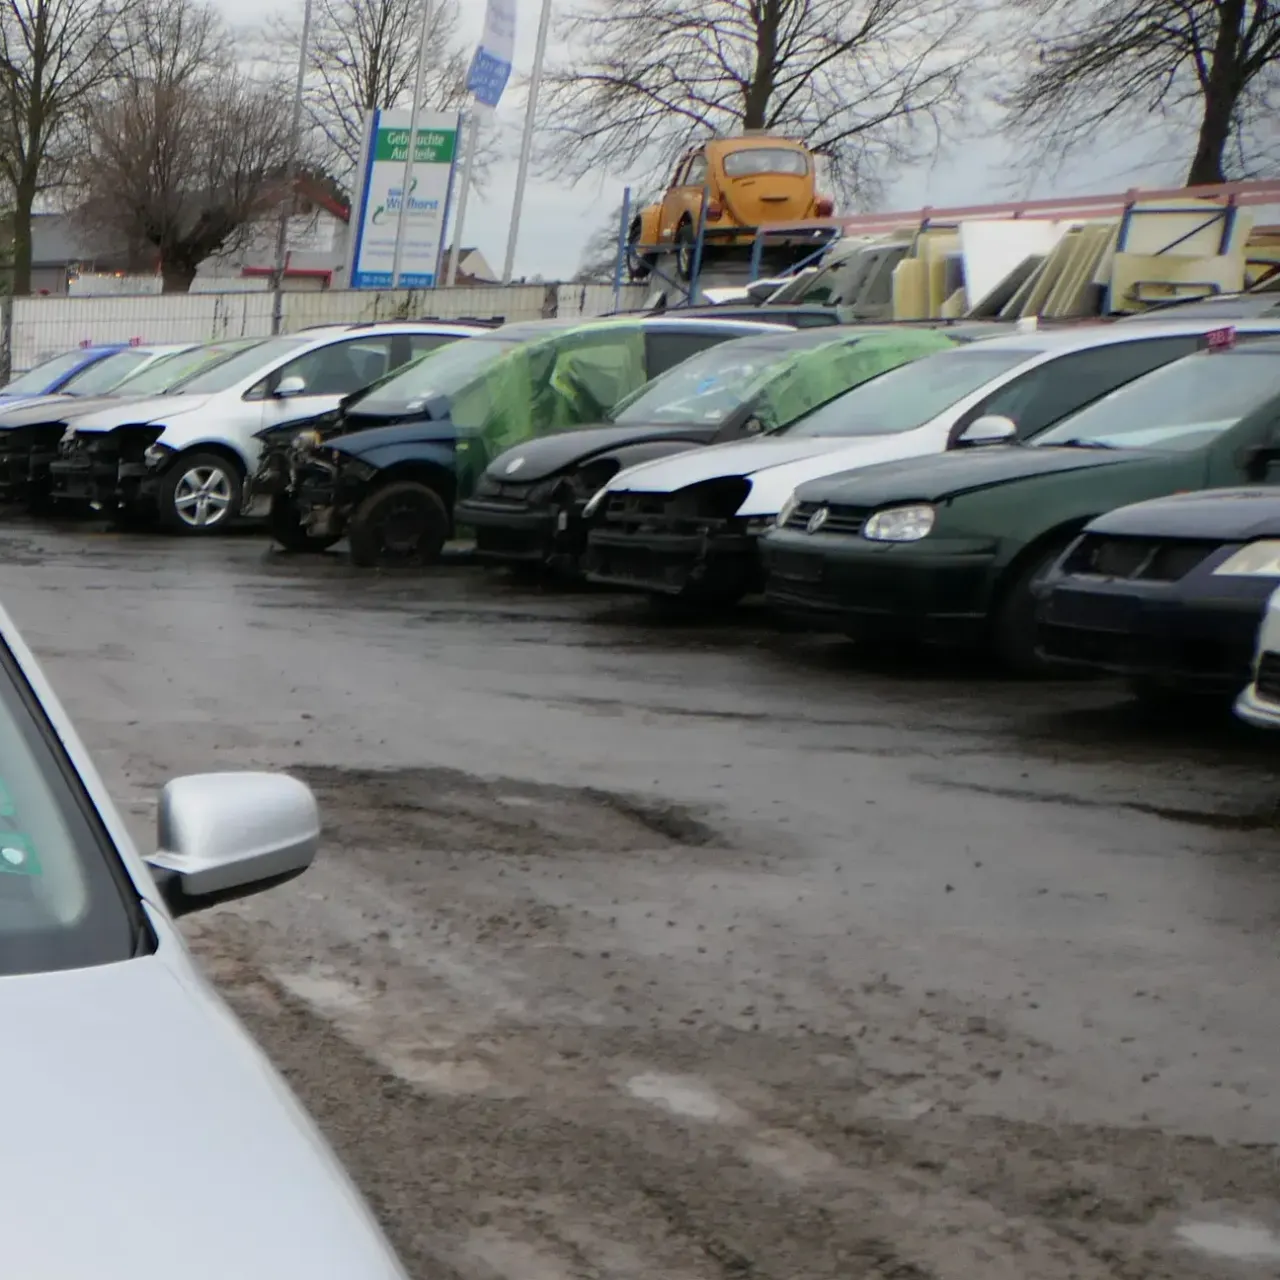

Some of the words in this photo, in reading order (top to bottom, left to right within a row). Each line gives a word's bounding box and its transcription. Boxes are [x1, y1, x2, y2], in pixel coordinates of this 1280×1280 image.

[387, 131, 444, 146] Gebuchte
[391, 147, 436, 160] Autteile
[386, 196, 438, 210] Wfhorst
